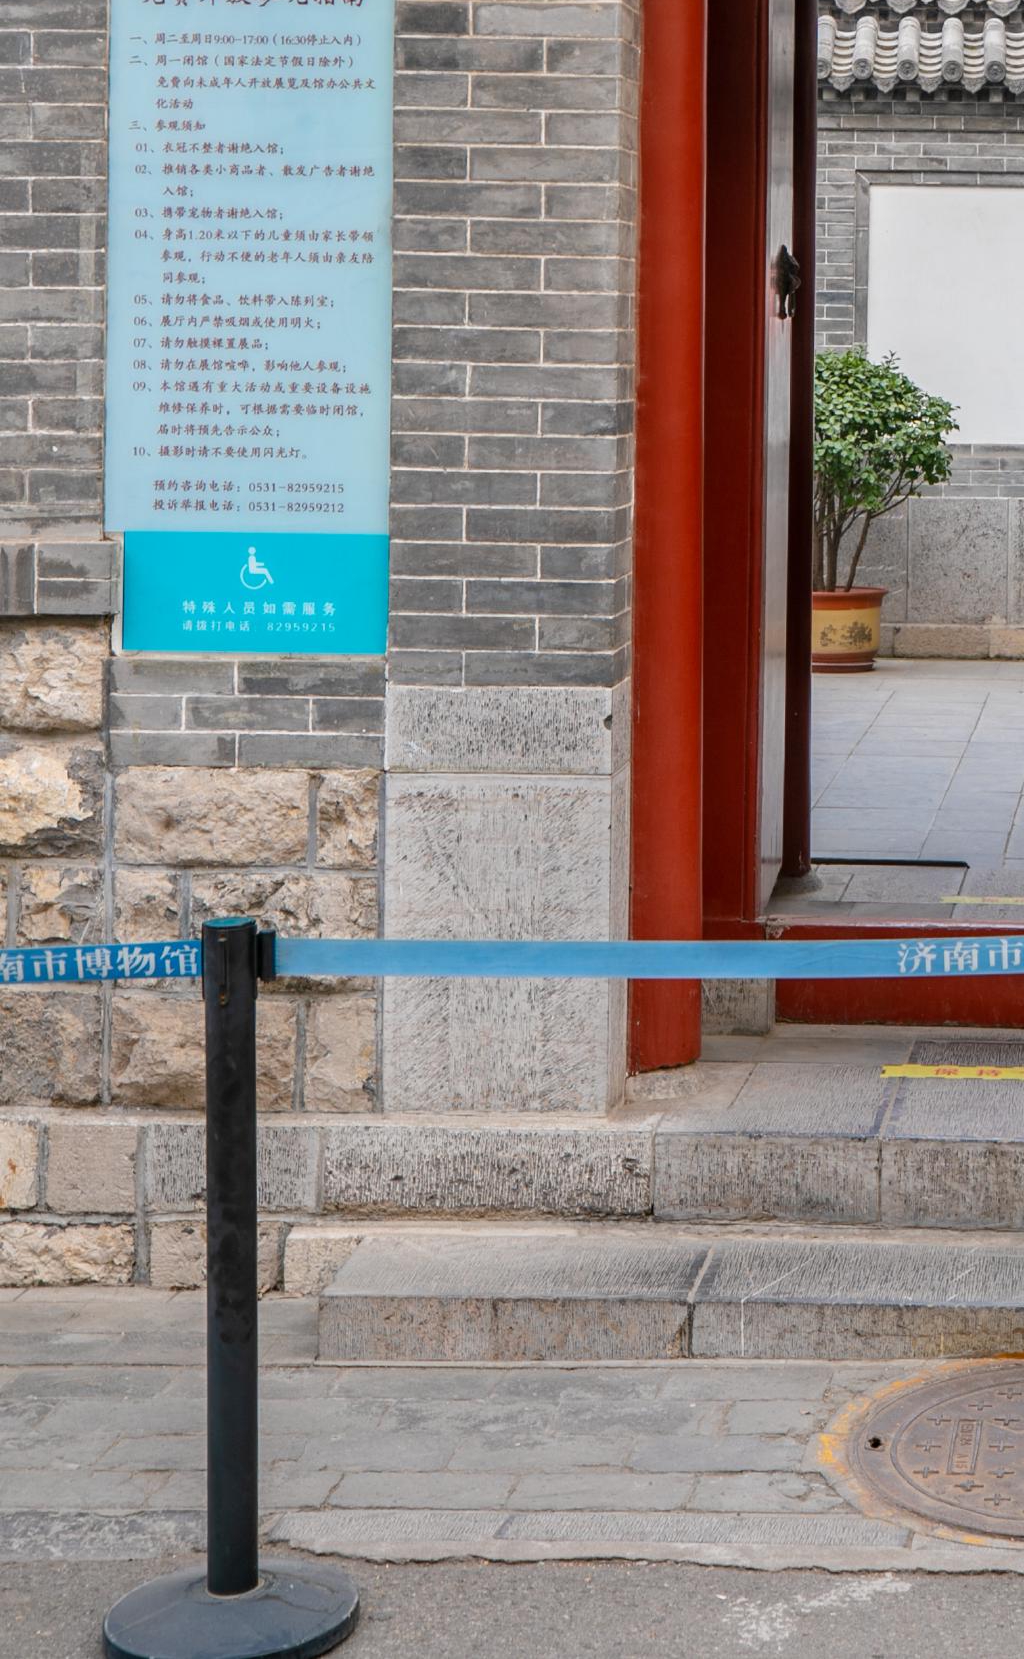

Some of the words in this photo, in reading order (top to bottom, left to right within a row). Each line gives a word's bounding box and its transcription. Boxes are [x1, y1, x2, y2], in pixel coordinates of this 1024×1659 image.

[156, 98, 194, 110] 化活动
[128, 120, 206, 131] 三、参观须知
[182, 600, 337, 617] 特殊人员如需服务
[0, 944, 199, 982] 南市博物馆
